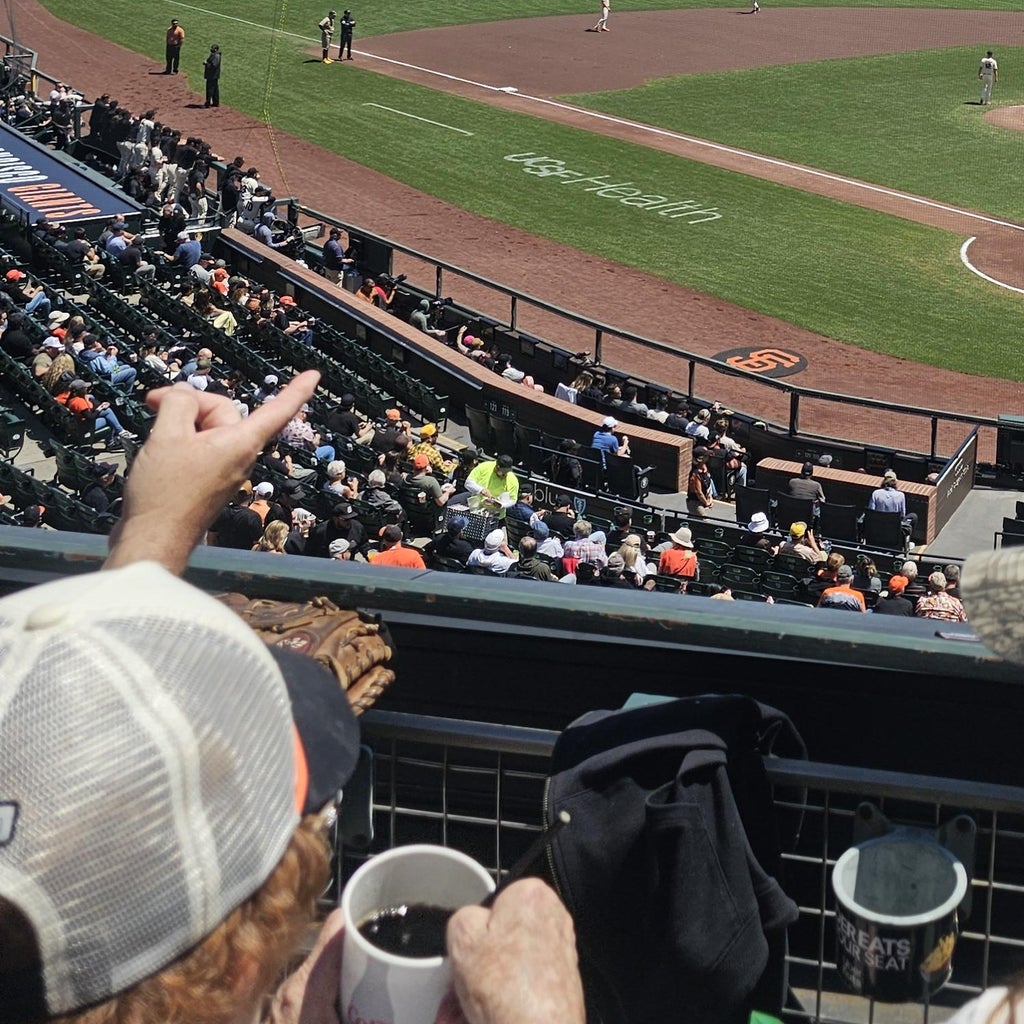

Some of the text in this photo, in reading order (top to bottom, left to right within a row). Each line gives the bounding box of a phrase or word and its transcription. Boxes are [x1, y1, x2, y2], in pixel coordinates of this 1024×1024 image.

[7, 183, 101, 218] GIANTS
[504, 152, 723, 225] UCSF Health
[533, 483, 558, 506] blu
[858, 929, 911, 957] EATS
[864, 951, 909, 971] SEAT
